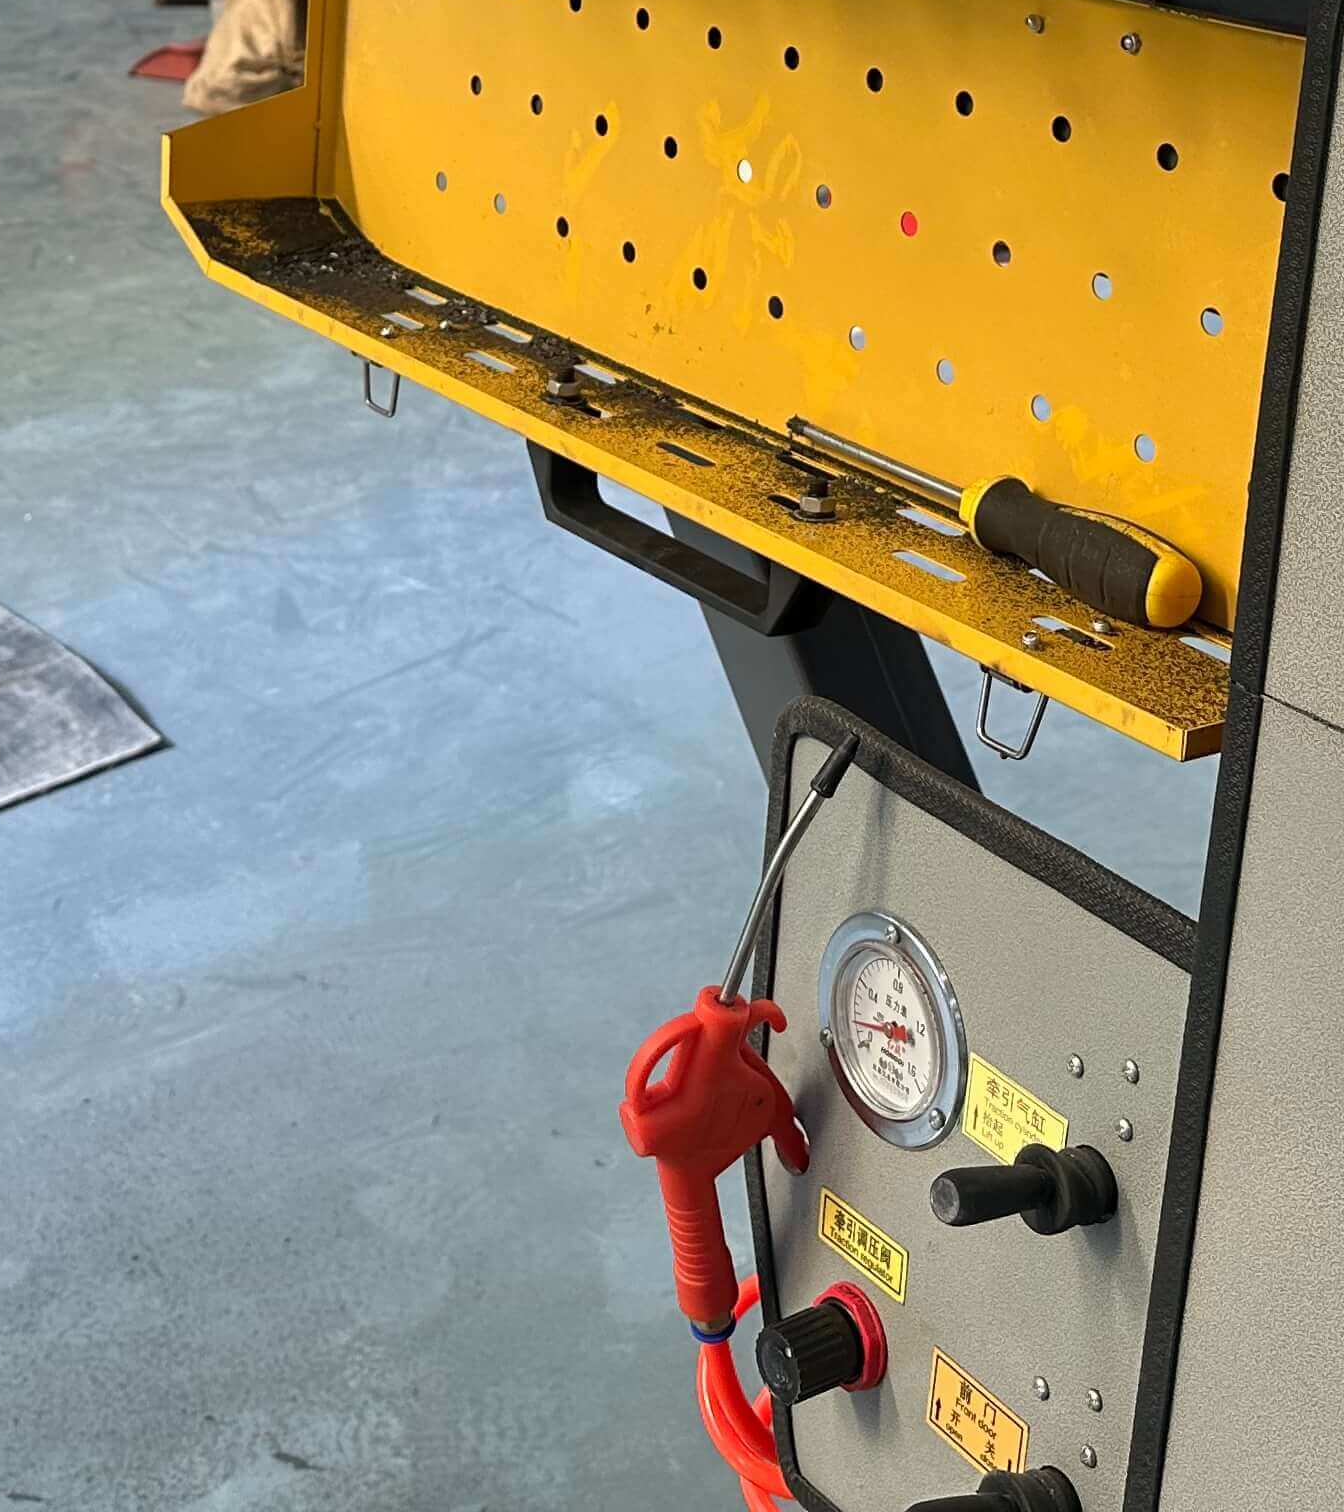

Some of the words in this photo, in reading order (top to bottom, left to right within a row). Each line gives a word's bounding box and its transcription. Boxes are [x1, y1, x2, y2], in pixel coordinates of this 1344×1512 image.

[986, 1077, 1046, 1136] 牵引气缸
[829, 1225, 859, 1256] Traction
[834, 1209, 892, 1270] 牵引调压阀
[950, 1408, 961, 1427] 开
[955, 1397, 977, 1424] Front
[977, 1419, 997, 1441] door
[984, 1440, 996, 1460] 关
